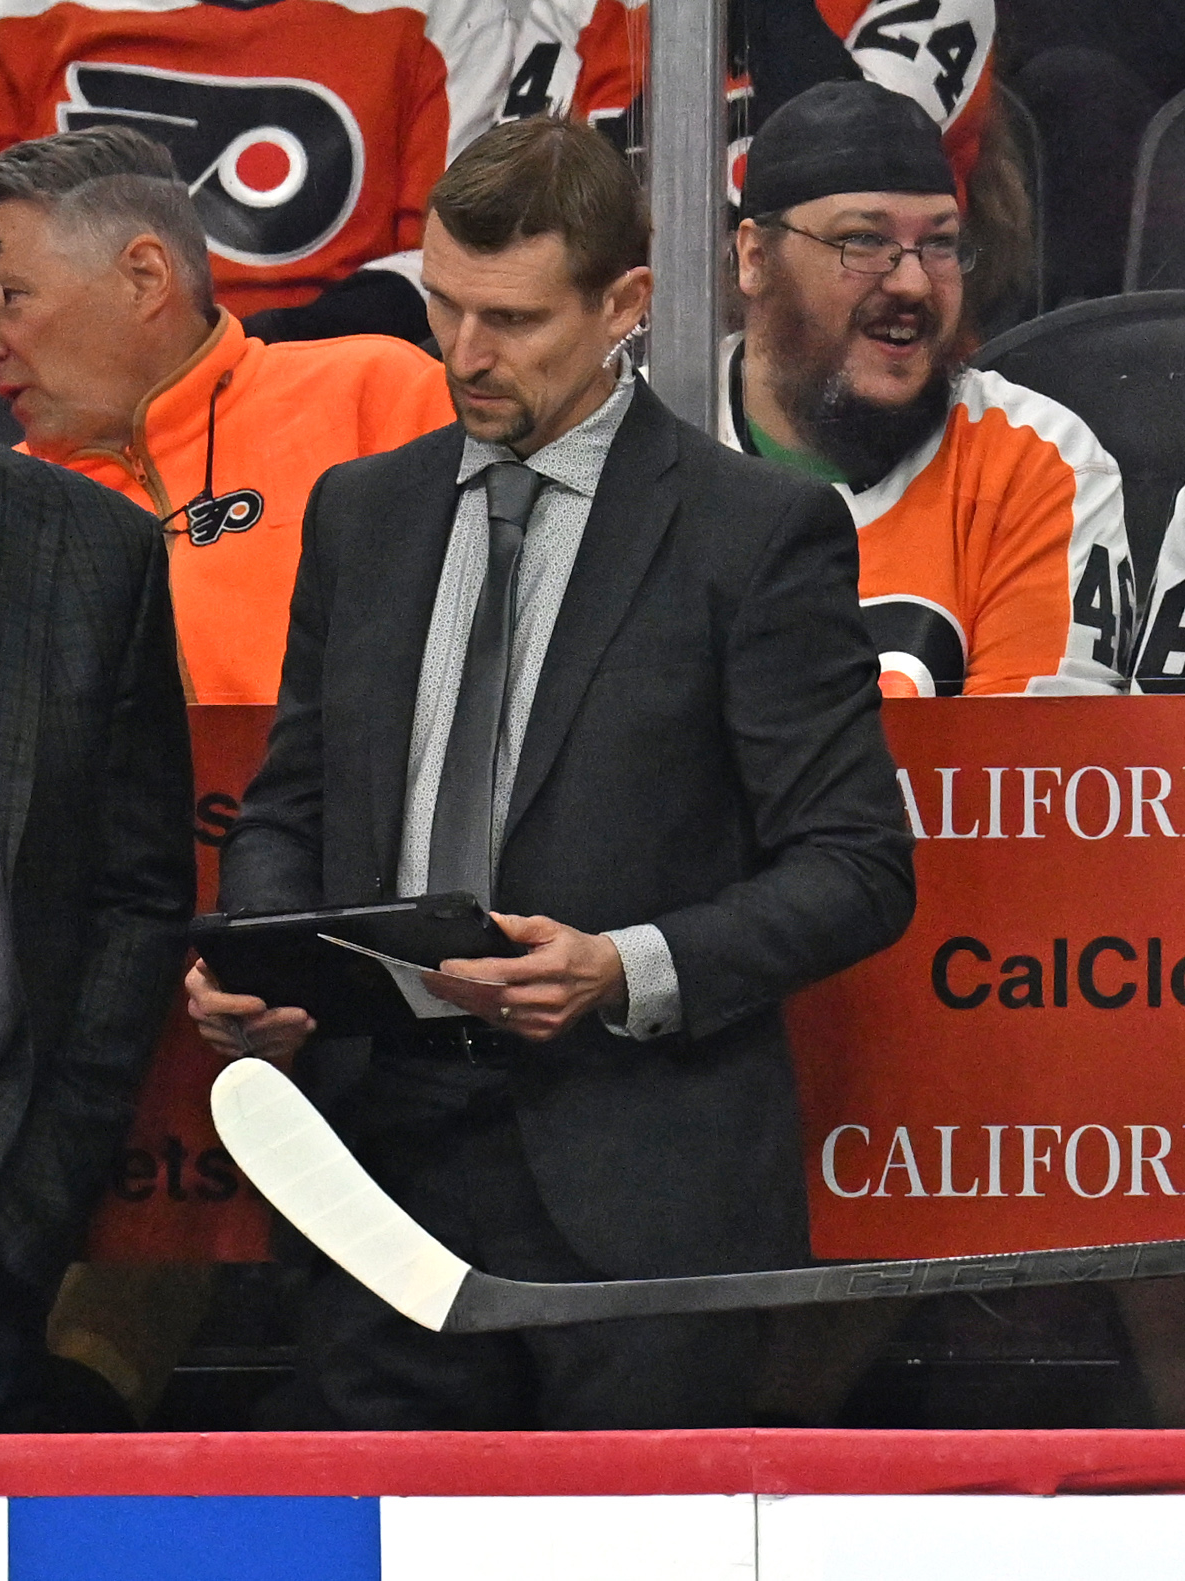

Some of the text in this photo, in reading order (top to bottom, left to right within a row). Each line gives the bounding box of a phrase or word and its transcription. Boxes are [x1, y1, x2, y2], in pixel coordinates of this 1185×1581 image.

[503, 42, 562, 117] 4
[896, 766, 1185, 840] ALIFOR
[821, 1124, 1185, 1199] CALIFOR
